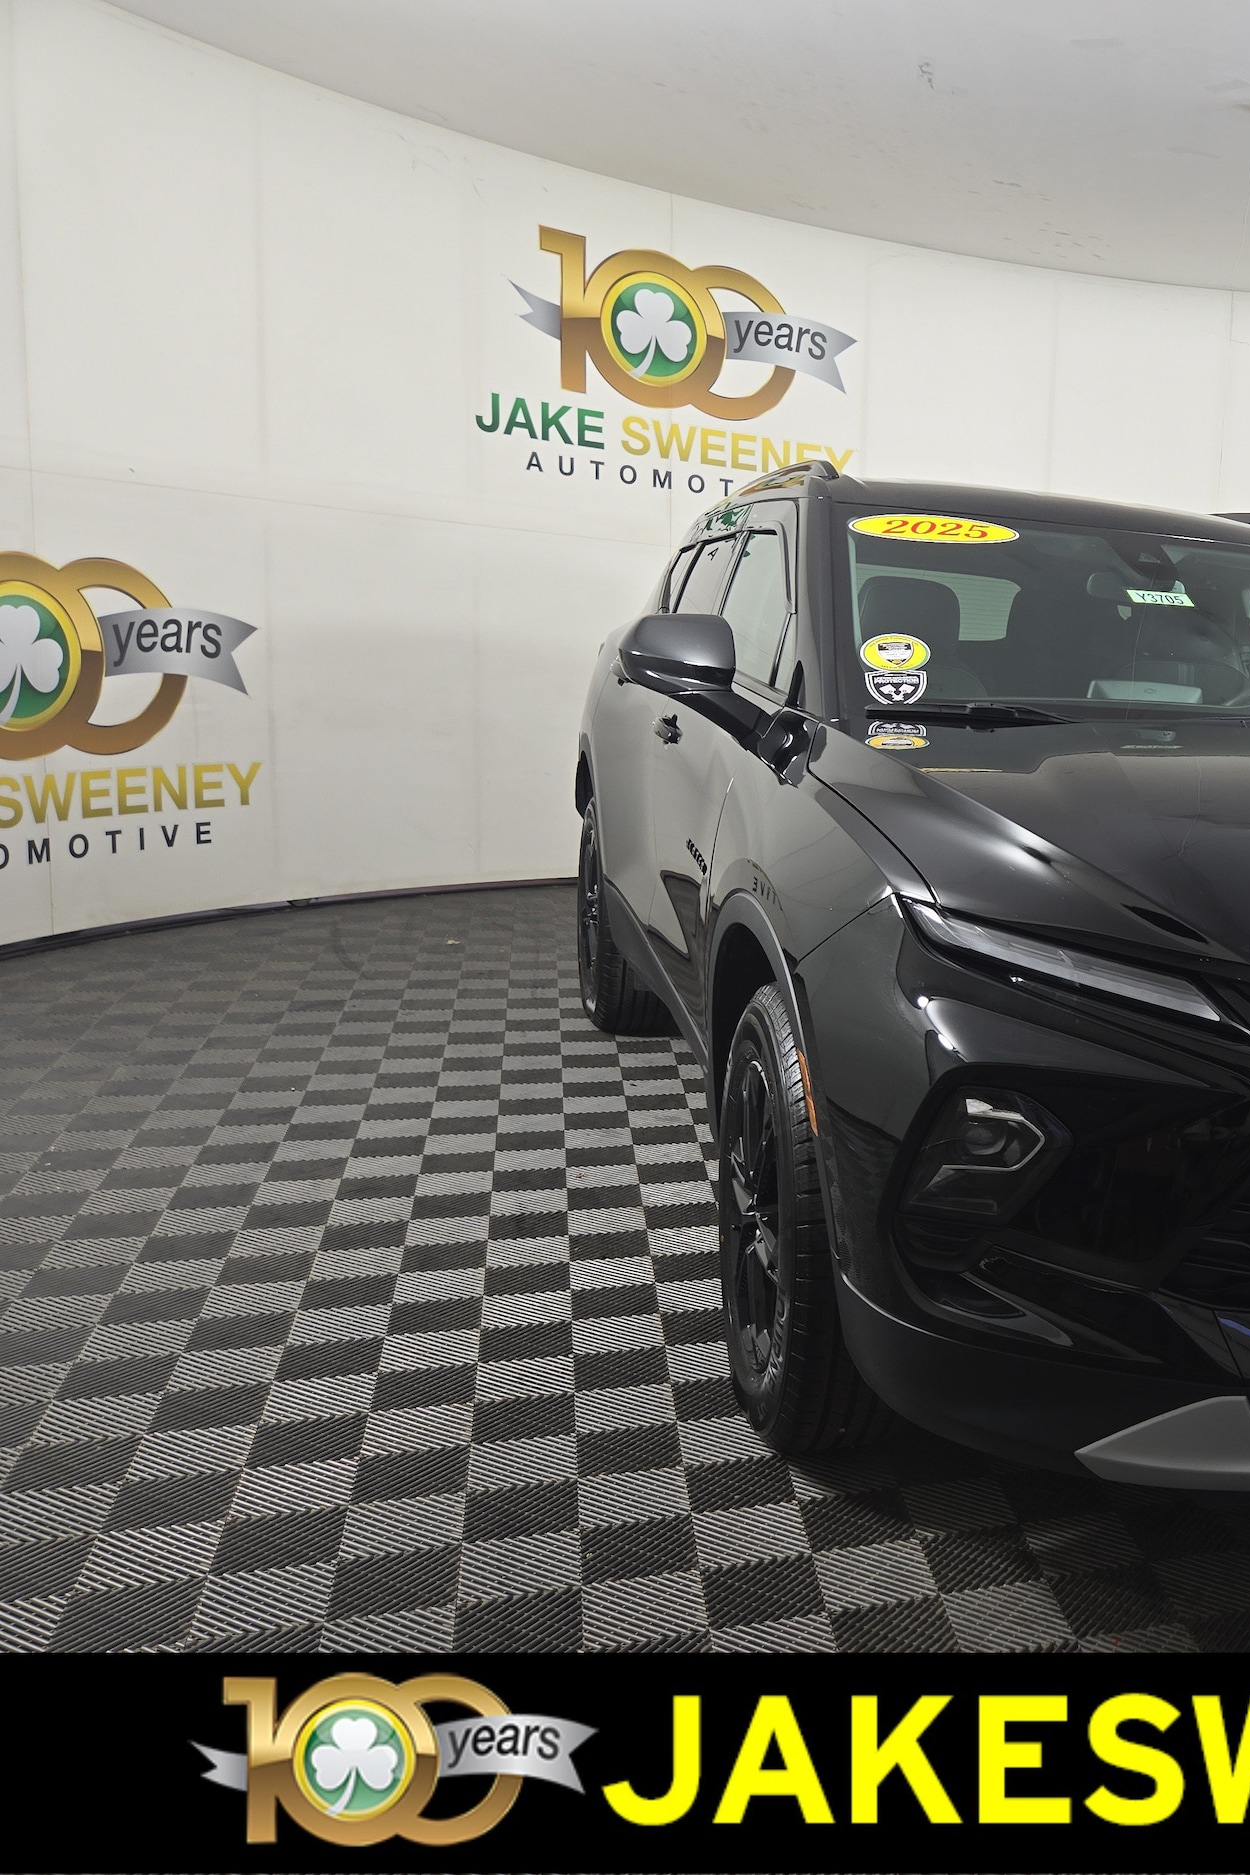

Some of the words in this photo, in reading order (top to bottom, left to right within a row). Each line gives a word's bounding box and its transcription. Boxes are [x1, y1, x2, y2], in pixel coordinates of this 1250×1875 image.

[733, 319, 828, 360] years
[475, 392, 605, 450] JAKE
[526, 451, 735, 497] AUTOMOT
[881, 519, 991, 539] 2025
[1135, 592, 1185, 605] Y3705
[112, 618, 224, 668] years
[0, 762, 262, 830] SWEENEY
